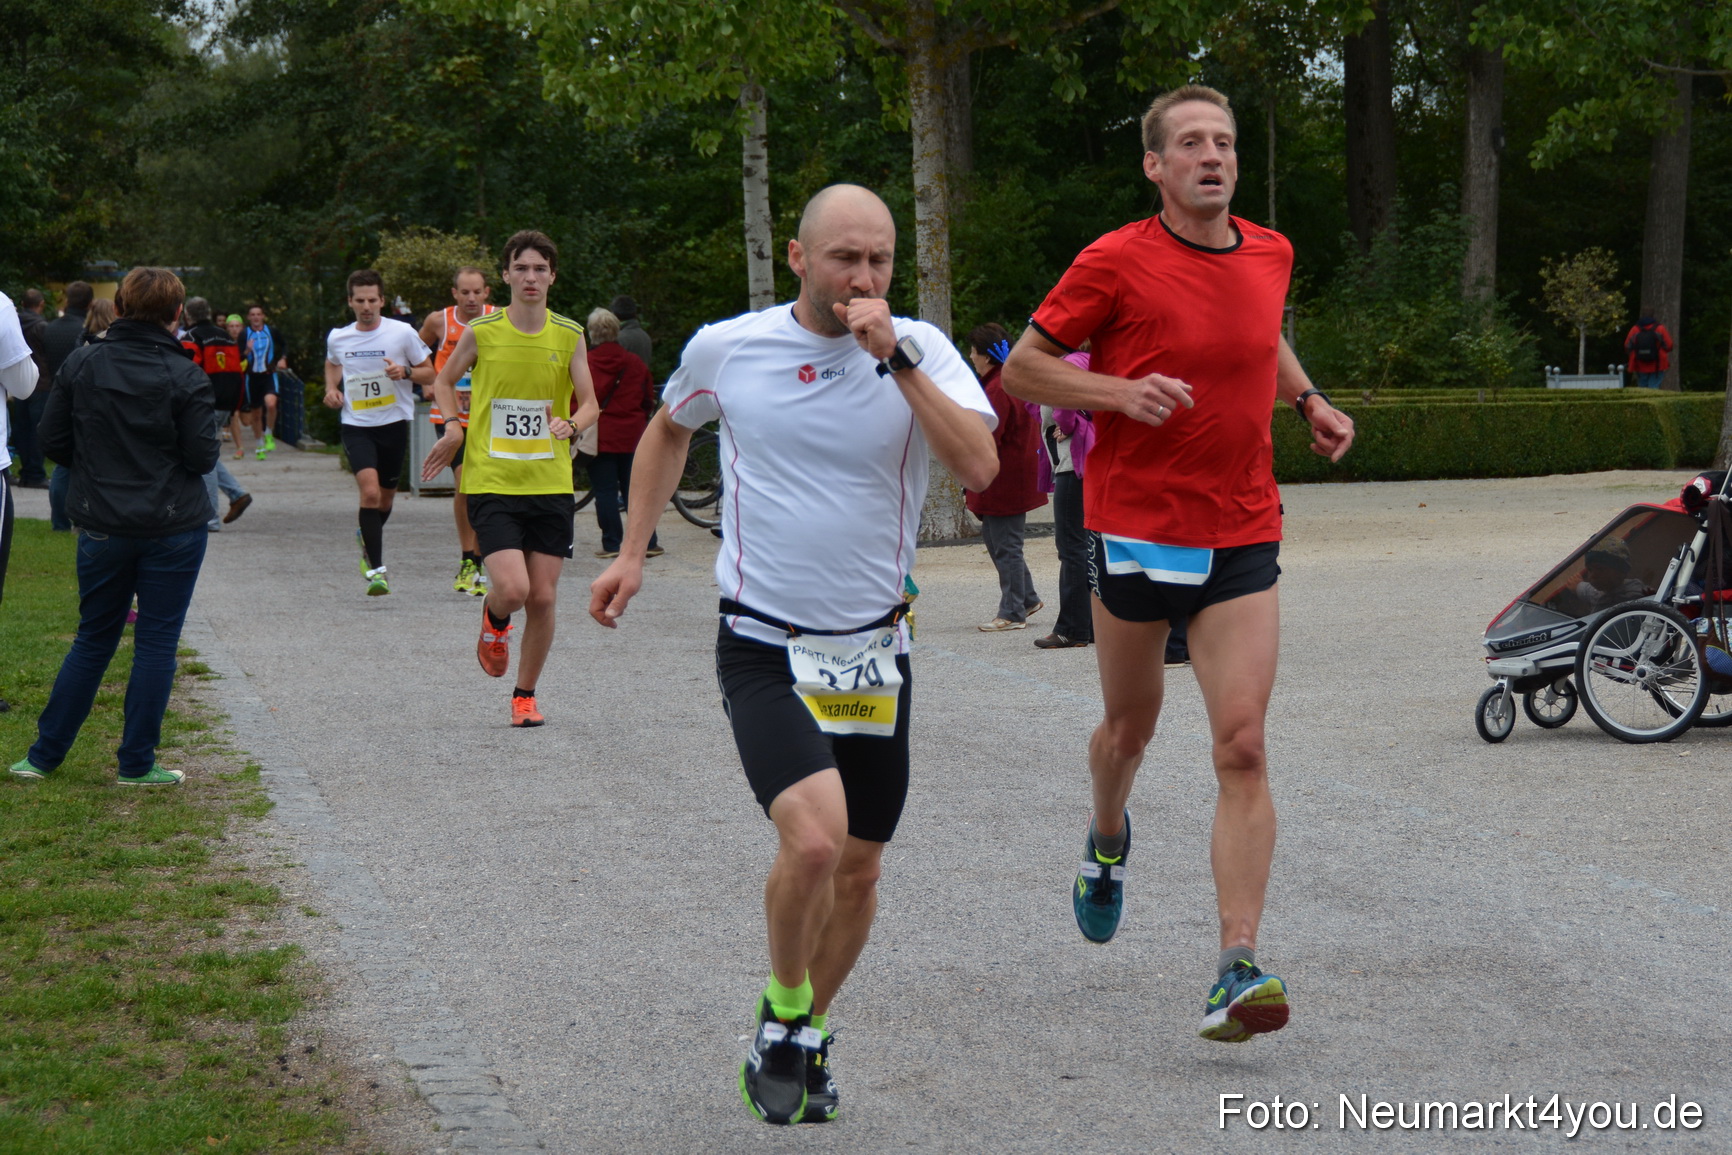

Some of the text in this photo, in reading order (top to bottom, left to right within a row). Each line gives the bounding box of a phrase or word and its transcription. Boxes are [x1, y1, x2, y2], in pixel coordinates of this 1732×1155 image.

[821, 367, 846, 380] dpd
[361, 381, 381, 398] 79
[493, 403, 516, 412] PARTL
[506, 414, 542, 436] 533
[1501, 632, 1547, 649] chariot
[793, 645, 829, 664] PARTL
